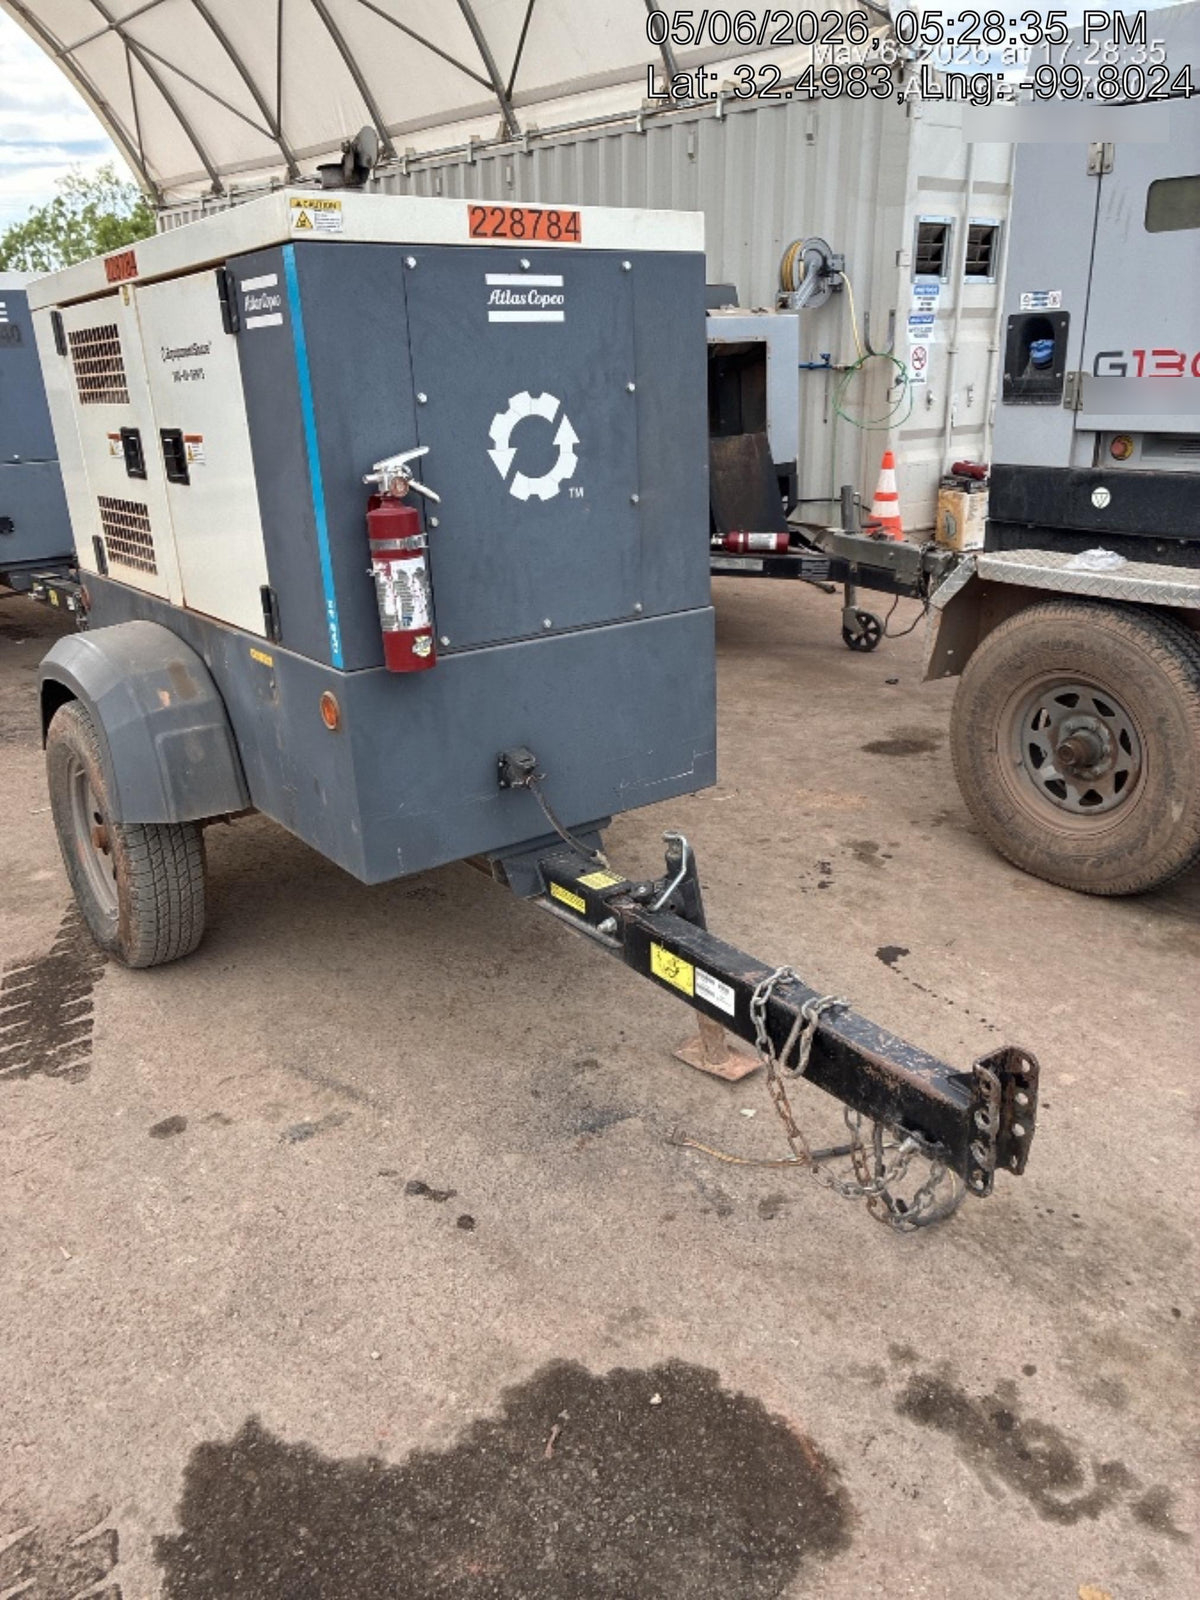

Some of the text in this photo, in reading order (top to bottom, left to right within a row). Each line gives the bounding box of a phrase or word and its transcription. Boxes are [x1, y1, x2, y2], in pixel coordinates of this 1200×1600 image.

[471, 206, 580, 241] 228784
[487, 289, 564, 308] Atlas Copco
[568, 486, 584, 499] TM
